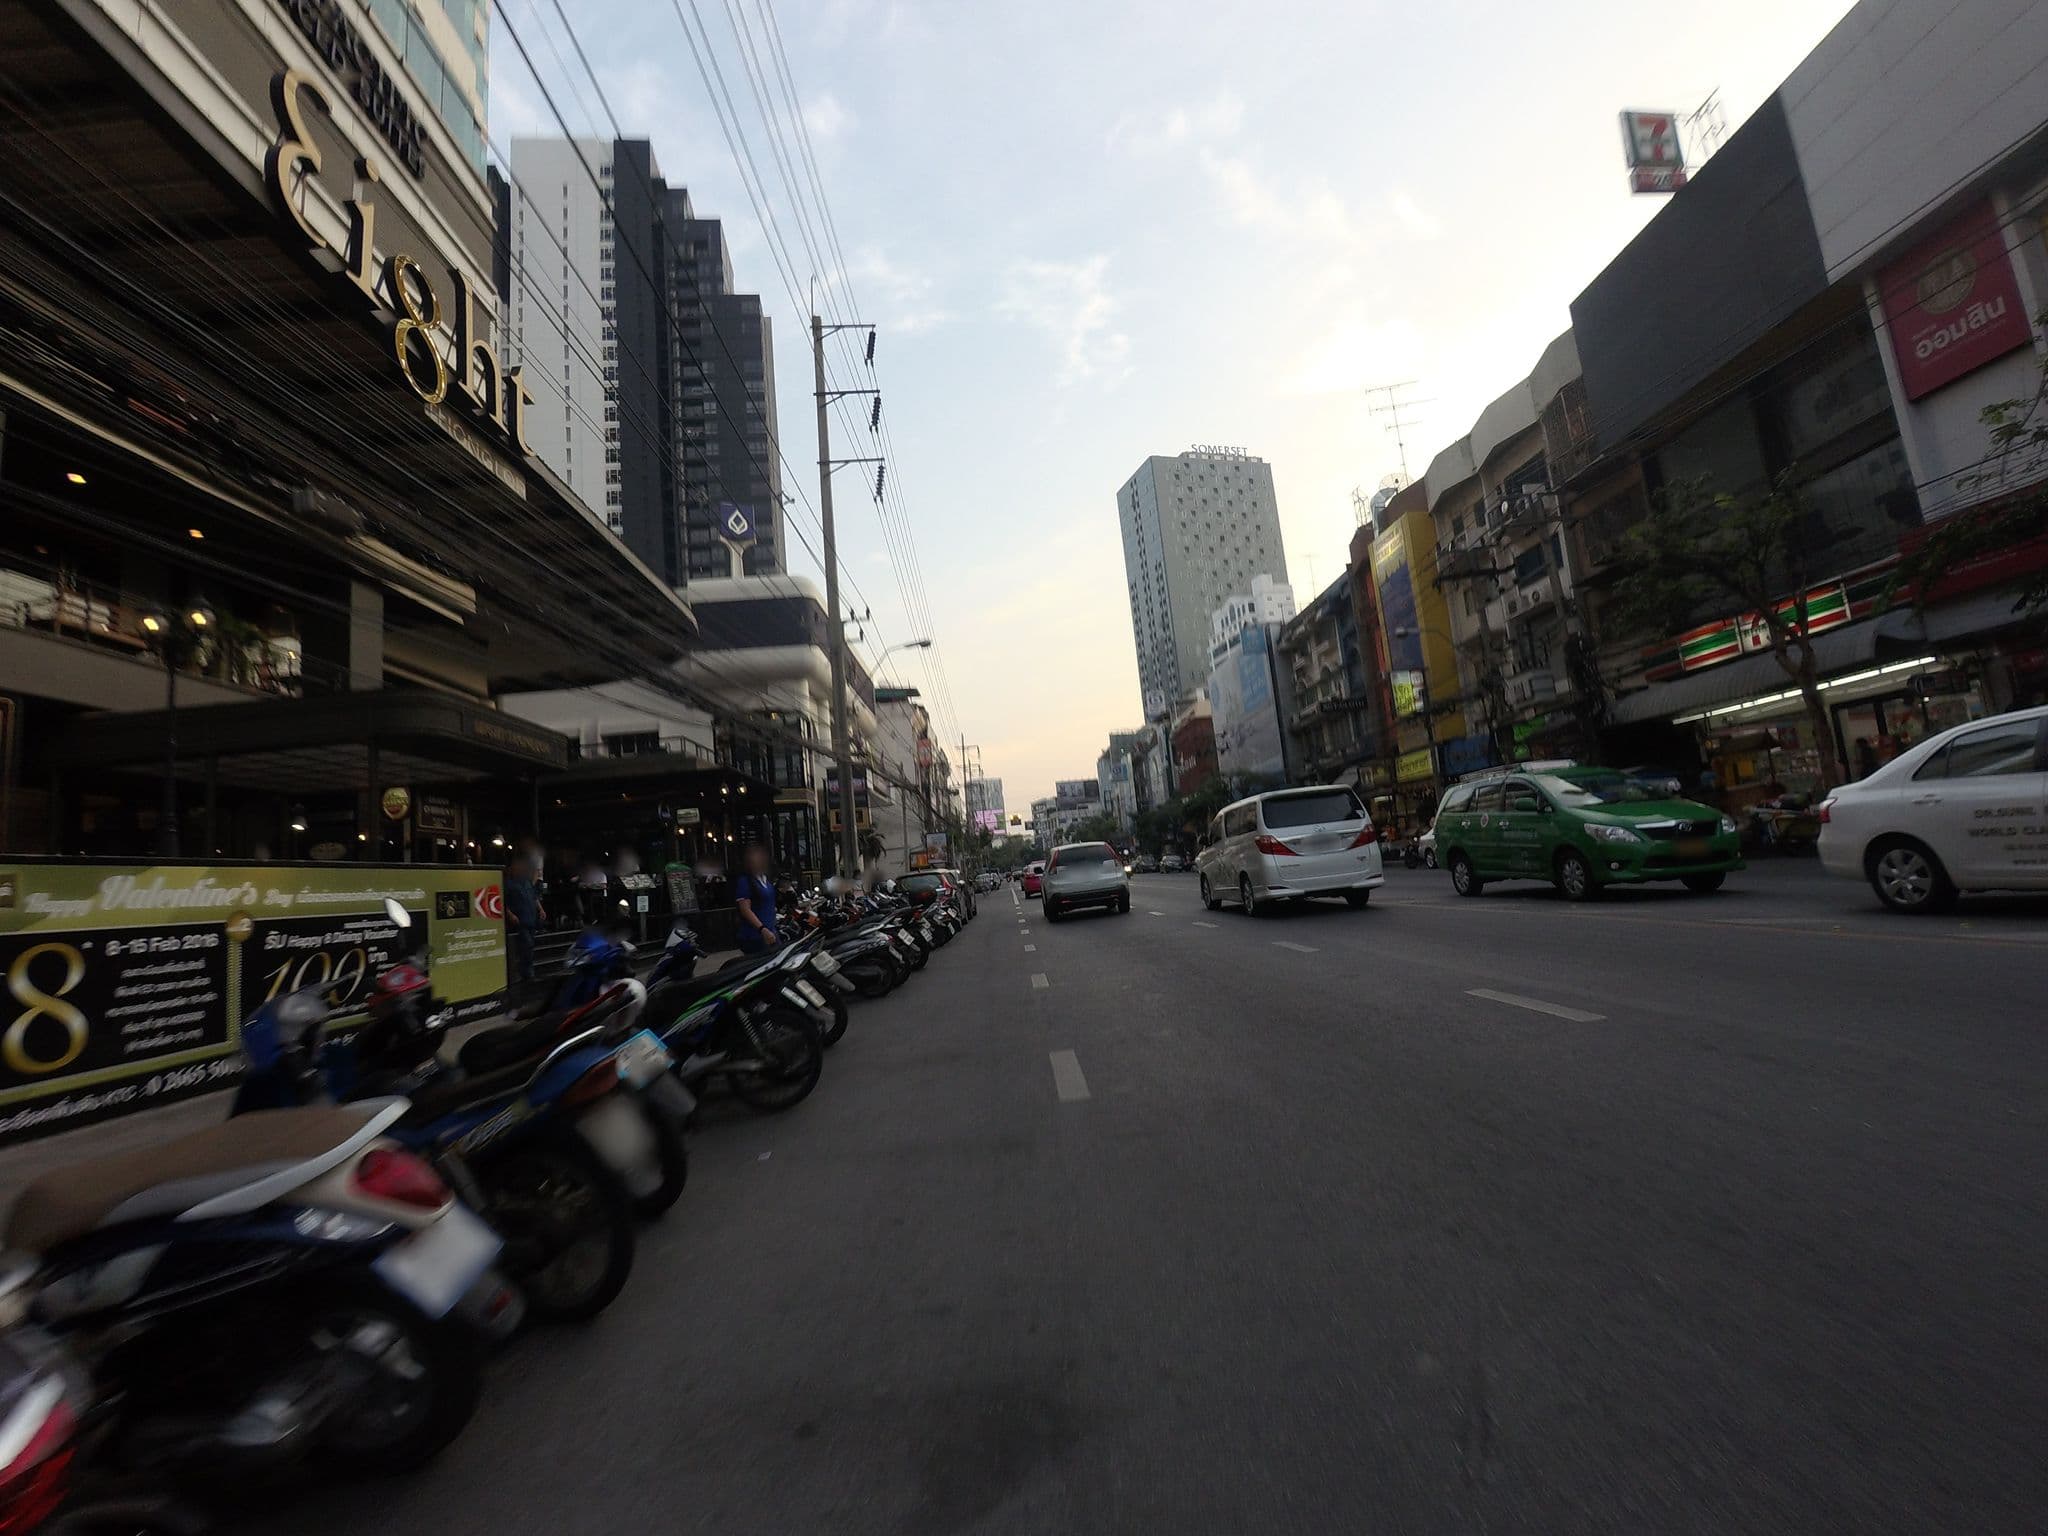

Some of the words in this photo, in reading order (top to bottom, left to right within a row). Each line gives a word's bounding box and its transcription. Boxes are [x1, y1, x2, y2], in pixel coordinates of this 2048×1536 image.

[1914, 296, 2007, 359] ออมสิน
[1191, 444, 1248, 457] SOMERSET
[98, 875, 258, 910] Valentine's
[150, 935, 181, 952] Feb
[2, 942, 91, 1074] 8
